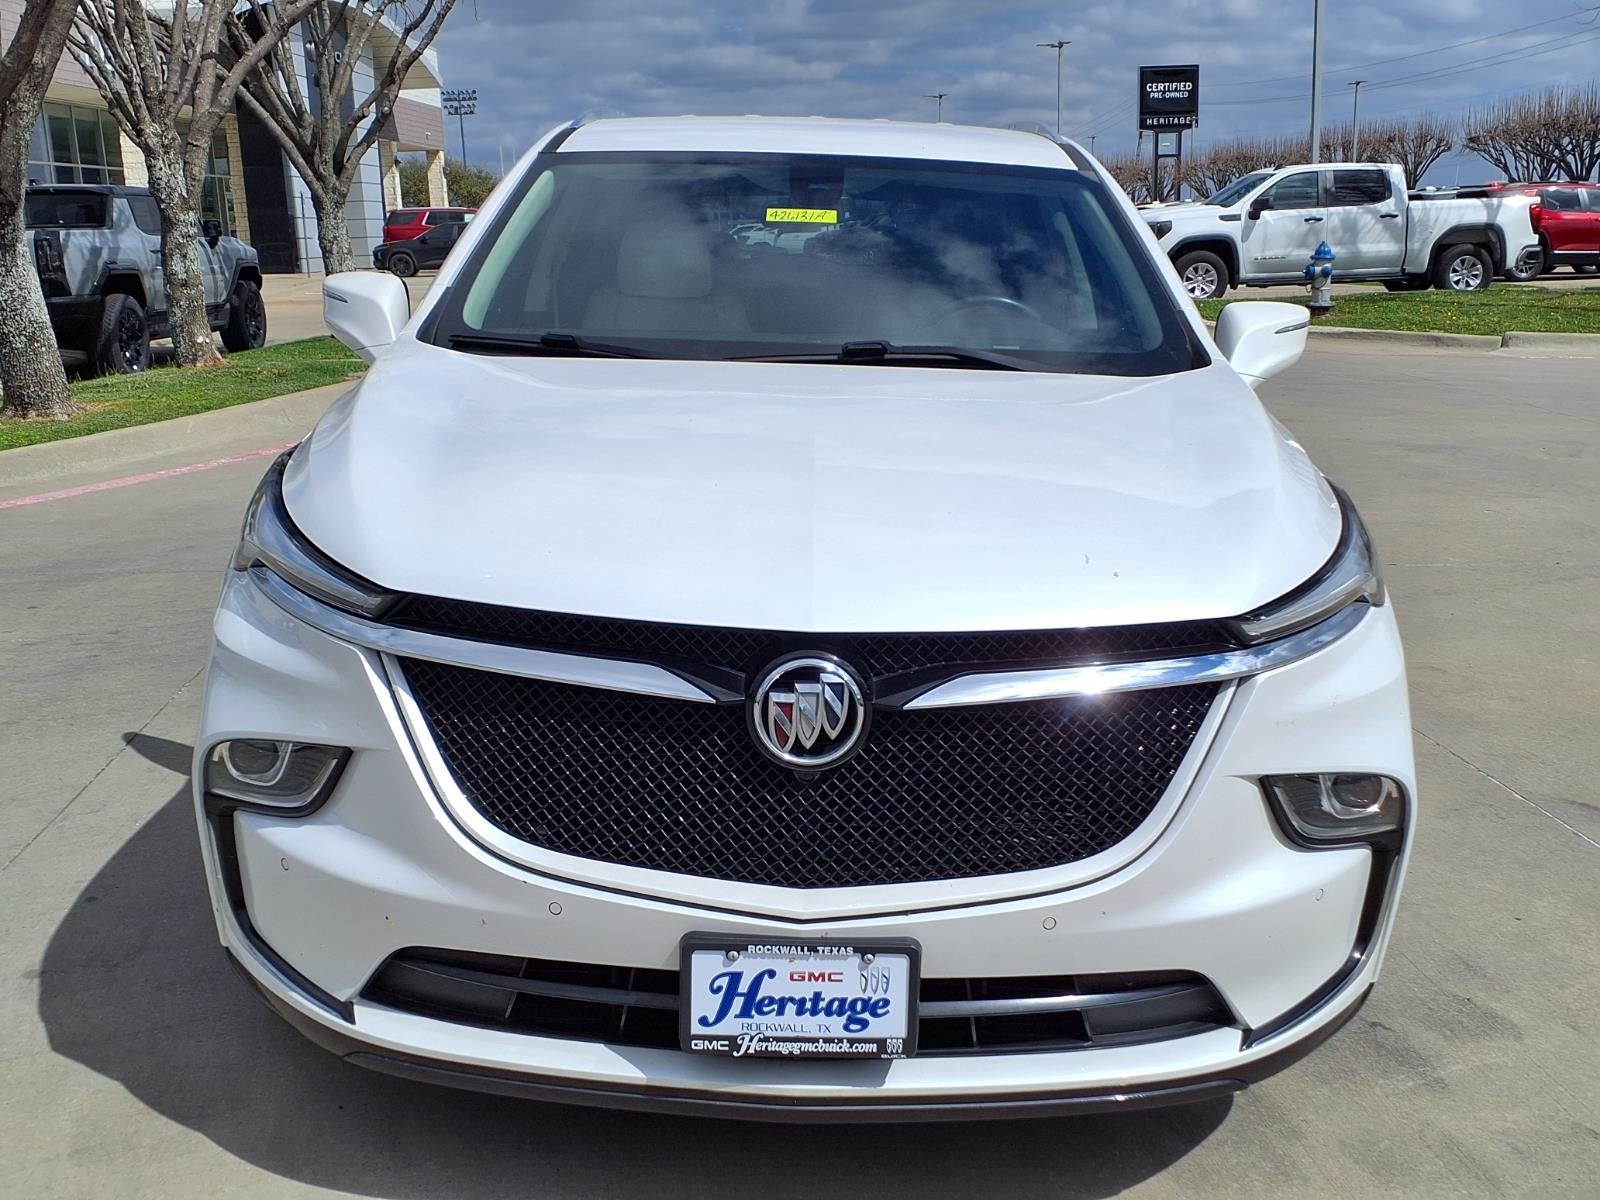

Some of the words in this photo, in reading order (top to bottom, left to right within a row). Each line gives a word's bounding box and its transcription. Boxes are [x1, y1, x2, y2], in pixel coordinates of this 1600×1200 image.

[1146, 82, 1192, 92] CERTIFIED
[1146, 117, 1191, 126] HERITAGE
[748, 945, 814, 956] ROCKWALL,
[817, 946, 854, 956] TEXAS
[789, 971, 844, 983] GMC
[697, 968, 891, 1033] Heritage
[741, 1022, 811, 1034] ROCKWALL,
[816, 1023, 832, 1034] TX
[691, 1040, 730, 1050] GMC
[733, 1033, 878, 1056] Heritagegmcbuick.com
